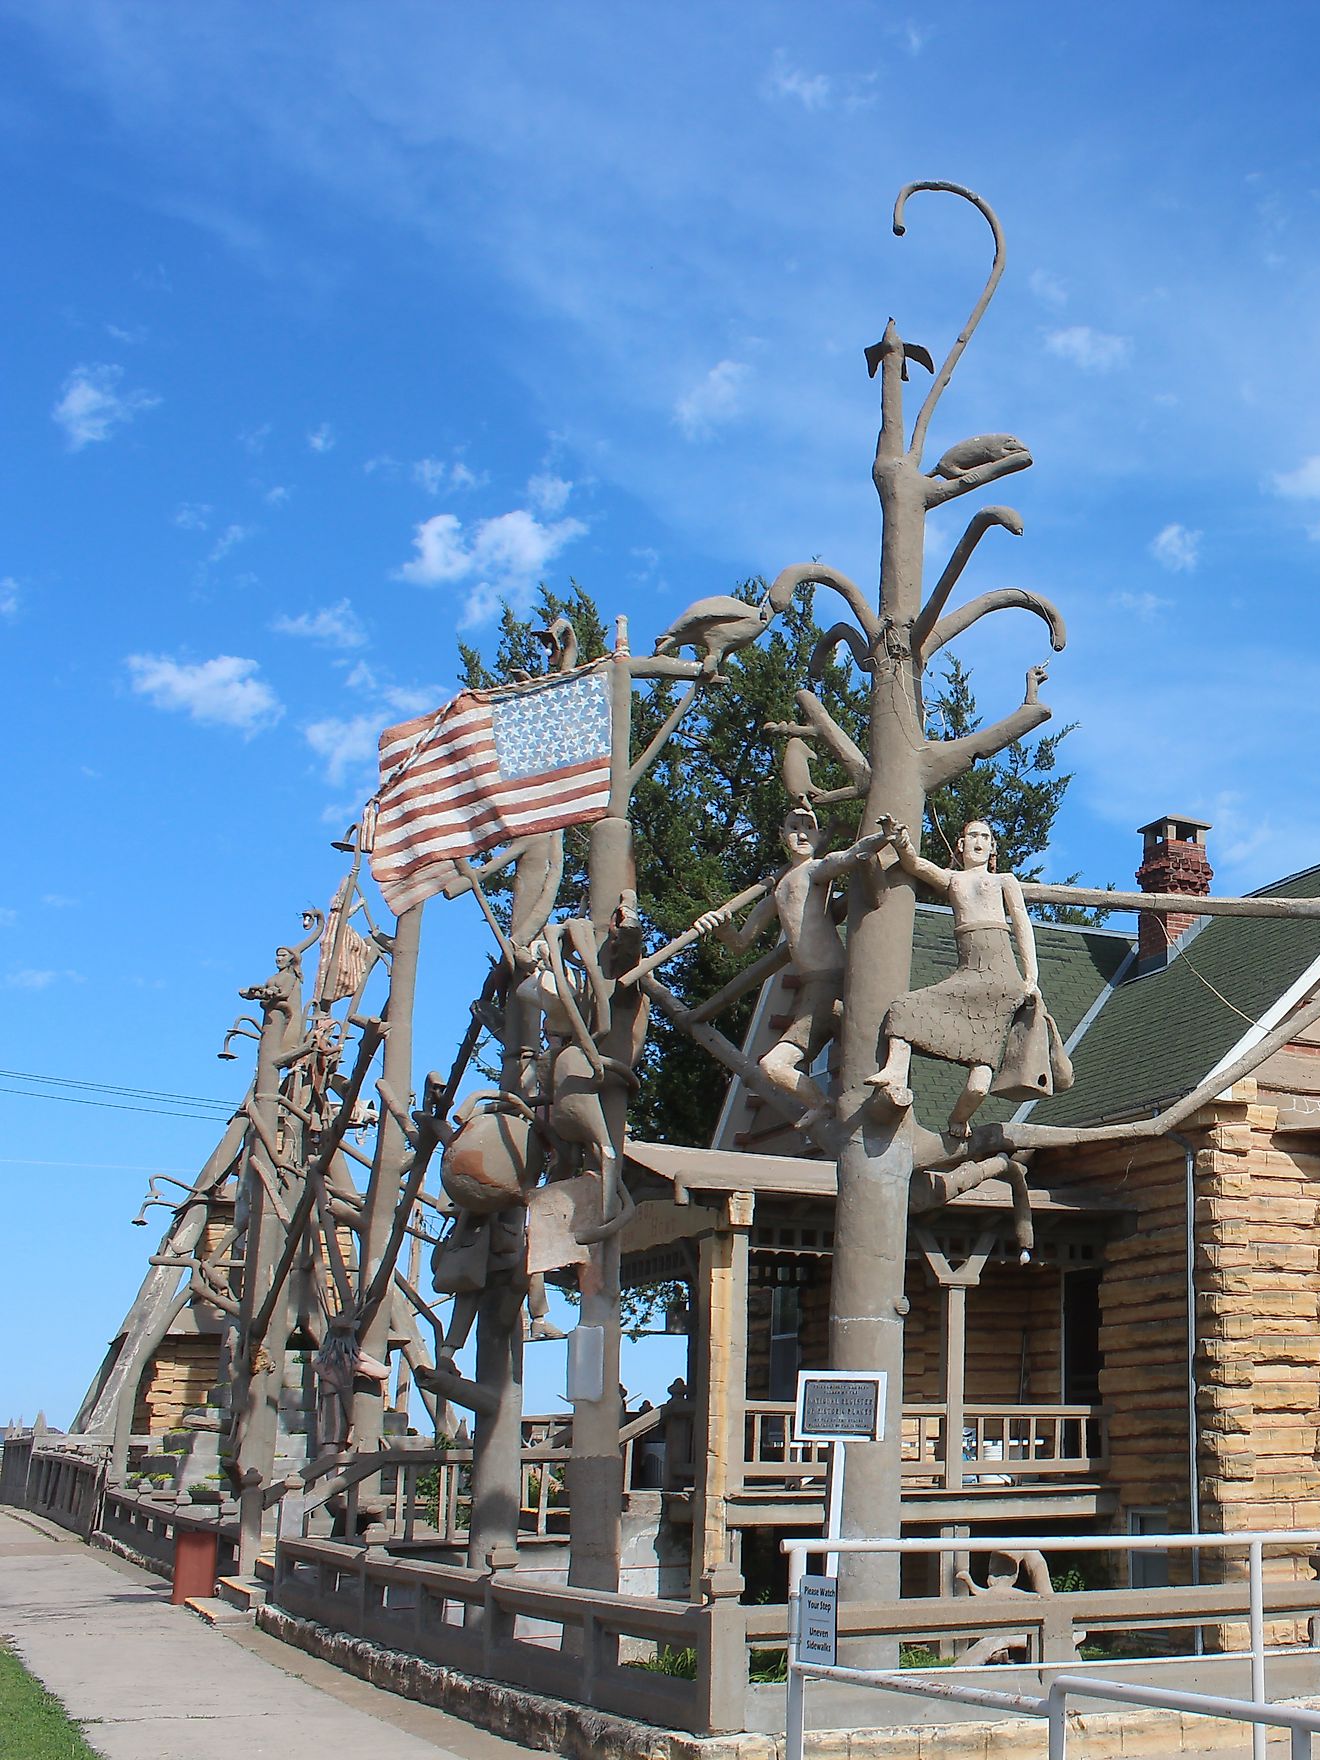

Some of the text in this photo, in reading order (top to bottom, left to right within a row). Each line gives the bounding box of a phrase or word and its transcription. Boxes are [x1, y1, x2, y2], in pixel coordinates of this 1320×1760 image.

[804, 1586, 835, 1598] Please Watch
[808, 1600, 832, 1613] Your Step
[810, 1627, 828, 1638] Uneven
[806, 1640, 831, 1652] Sidewalks
